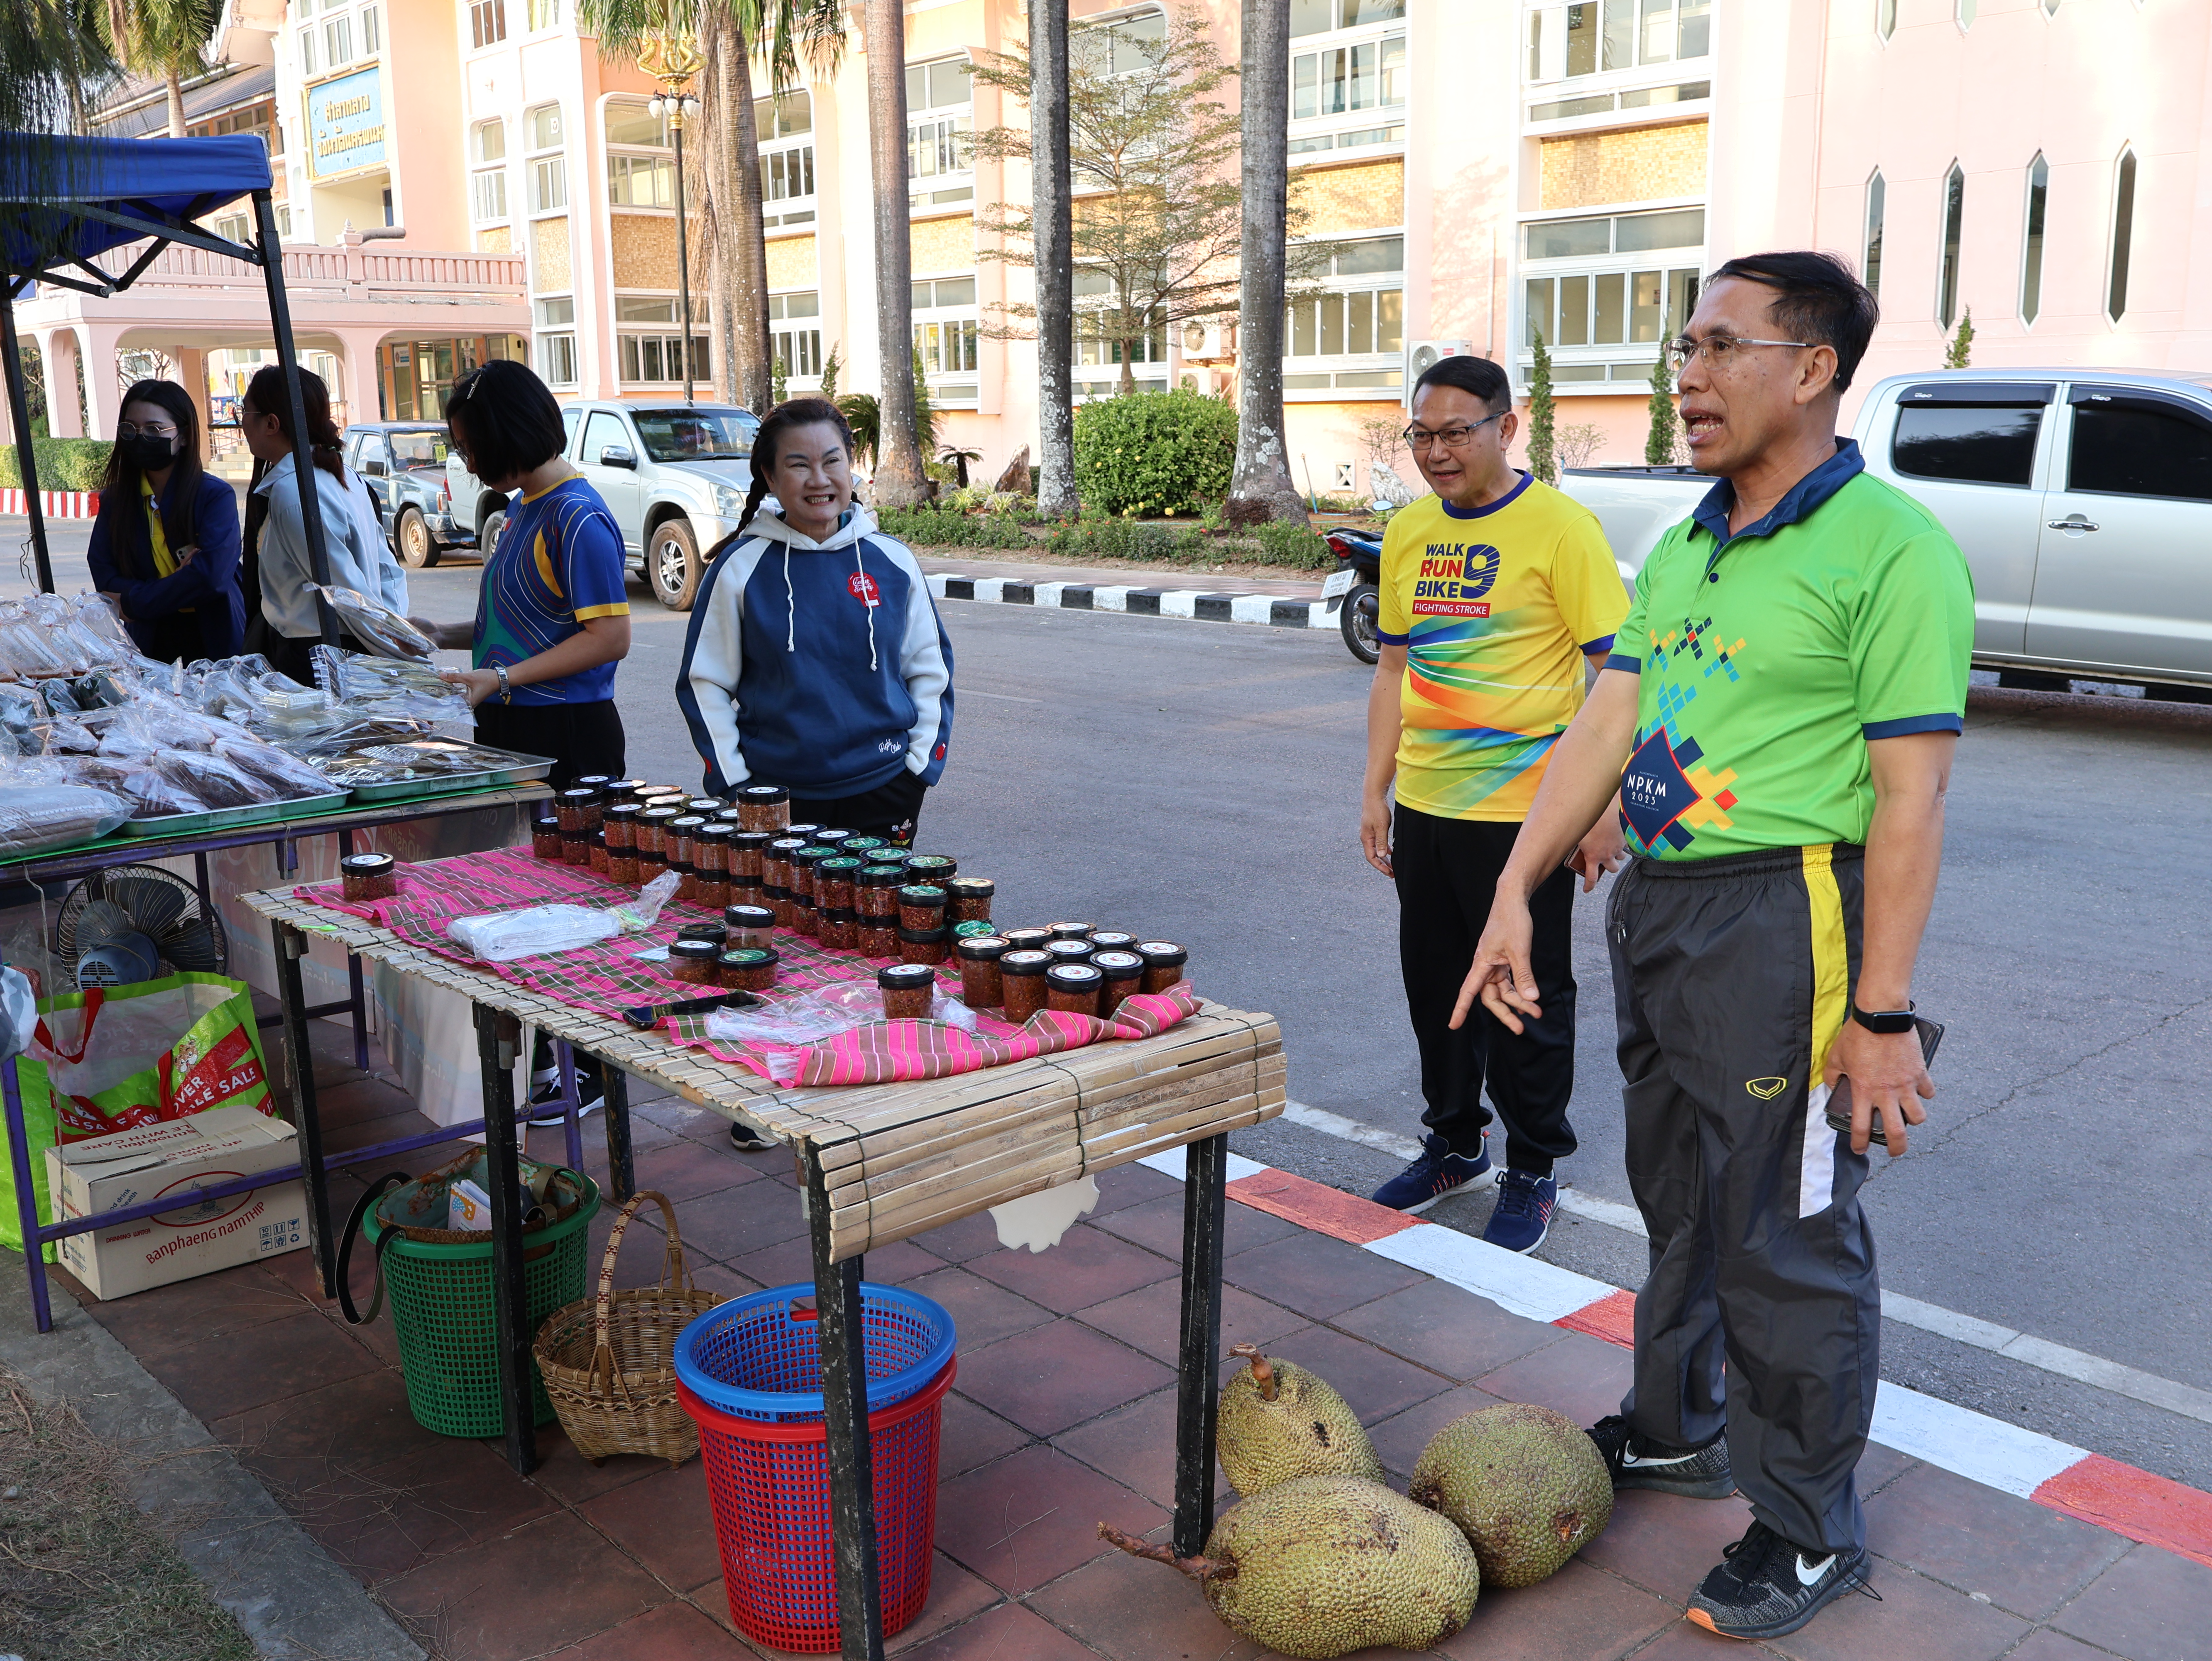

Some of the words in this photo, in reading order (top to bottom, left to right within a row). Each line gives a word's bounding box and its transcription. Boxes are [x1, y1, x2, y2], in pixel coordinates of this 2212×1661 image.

[1426, 543, 1465, 556] WALK
[1419, 559, 1463, 578] RUN
[1460, 544, 1500, 599] 9
[1414, 581, 1460, 598] BIKE
[1414, 603, 1453, 613] FIGHTING
[1455, 605, 1487, 615] STROKE
[878, 738, 892, 752] Fight
[891, 741, 901, 754] Club
[1627, 774, 1666, 797] NPKM
[1632, 791, 1656, 805] 2023
[218, 1067, 256, 1094] SALE
[129, 1130, 168, 1142] WITH
[80, 1139, 125, 1151] CARE
[182, 1146, 219, 1157] SIDE
[117, 1188, 131, 1203] drink
[120, 1191, 138, 1207] health
[106, 1233, 131, 1243] DRINKING
[133, 1228, 151, 1237] WATER
